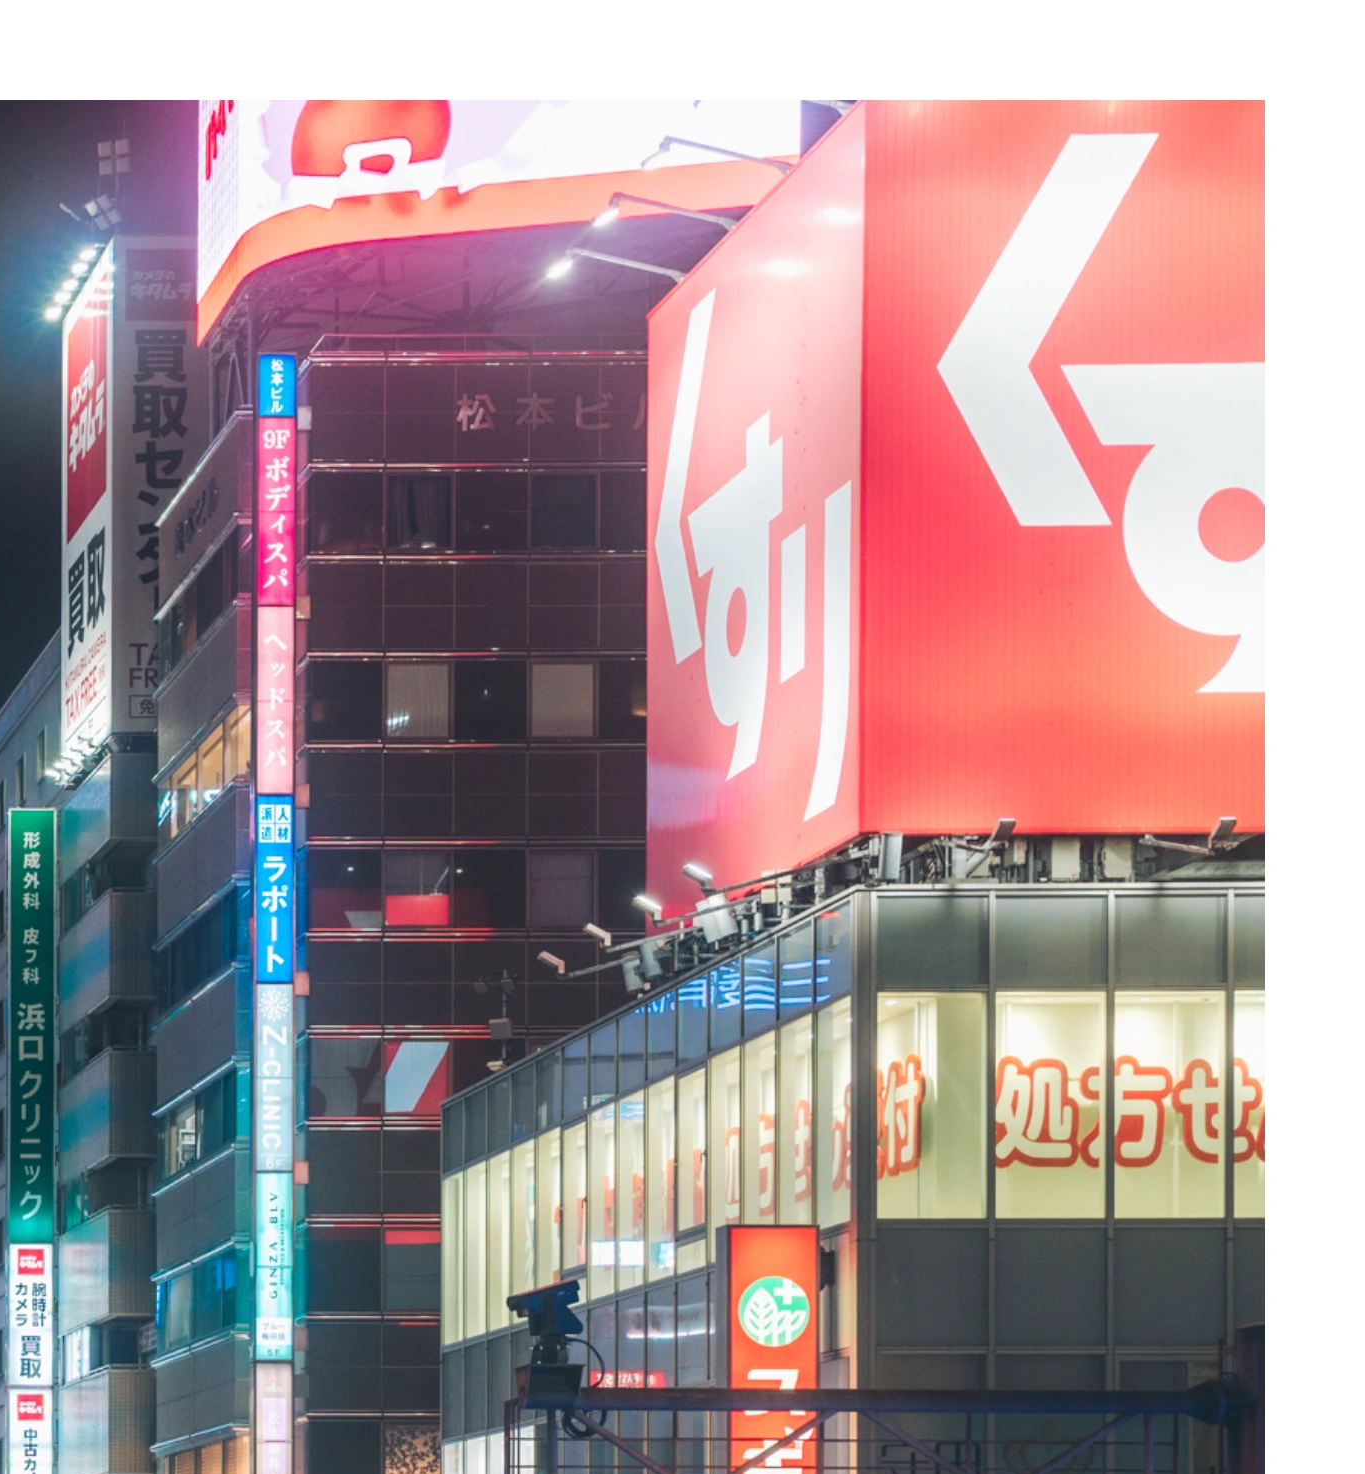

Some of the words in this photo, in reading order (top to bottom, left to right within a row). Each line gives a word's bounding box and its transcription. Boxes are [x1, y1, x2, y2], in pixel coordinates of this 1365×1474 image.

[269, 359, 285, 414] 松本ビル
[263, 430, 290, 450] 9F
[263, 458, 290, 589] ボディスパ
[654, 288, 852, 823] くすり
[129, 643, 159, 666] TA
[129, 669, 158, 688] FR
[263, 632, 288, 768] ヘッドスパ
[22, 831, 41, 911] 形成外科
[261, 855, 289, 974] ラポート
[995, 1054, 1265, 1170] 処方せ
[19, 1334, 41, 1379] 買取
